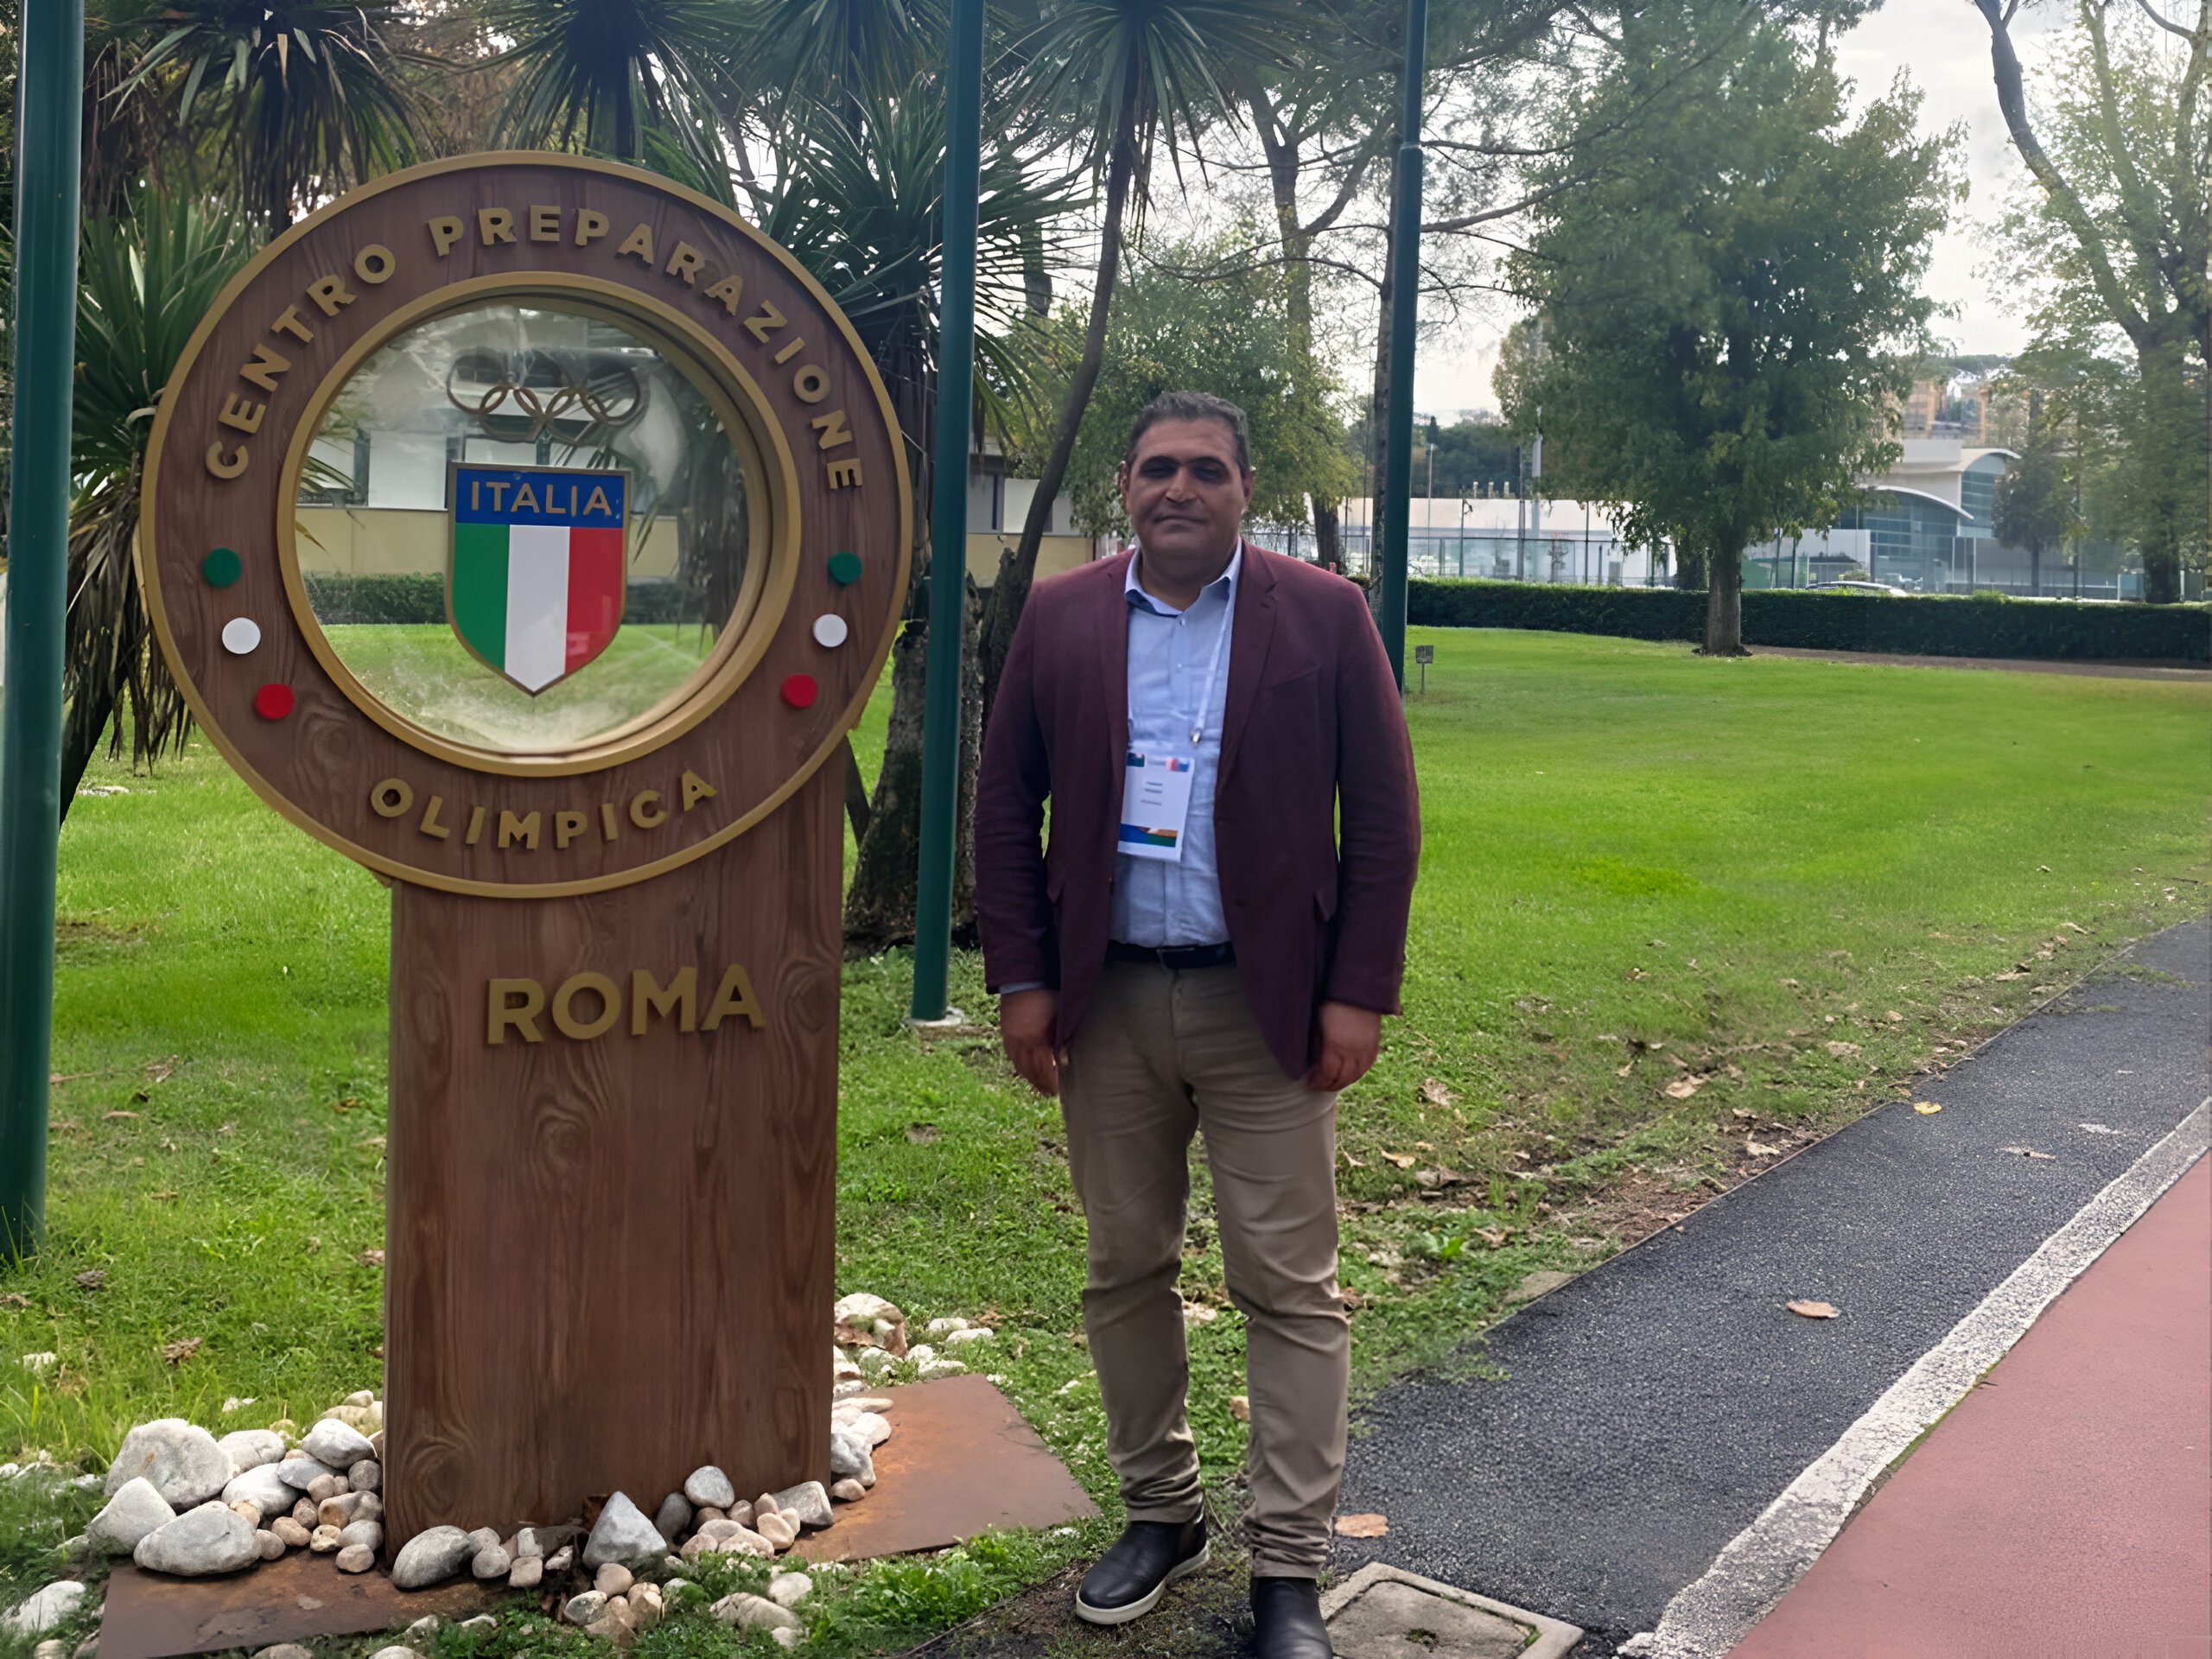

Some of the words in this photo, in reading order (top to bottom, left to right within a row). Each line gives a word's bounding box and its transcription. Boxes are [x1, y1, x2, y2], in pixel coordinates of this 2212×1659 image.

[207, 244, 396, 479] CENTRO
[429, 205, 862, 490] PREPARAZIONE
[471, 480, 613, 518] ITALIA
[371, 770, 717, 849] OLIMPICA
[486, 963, 766, 1045] ROMA
